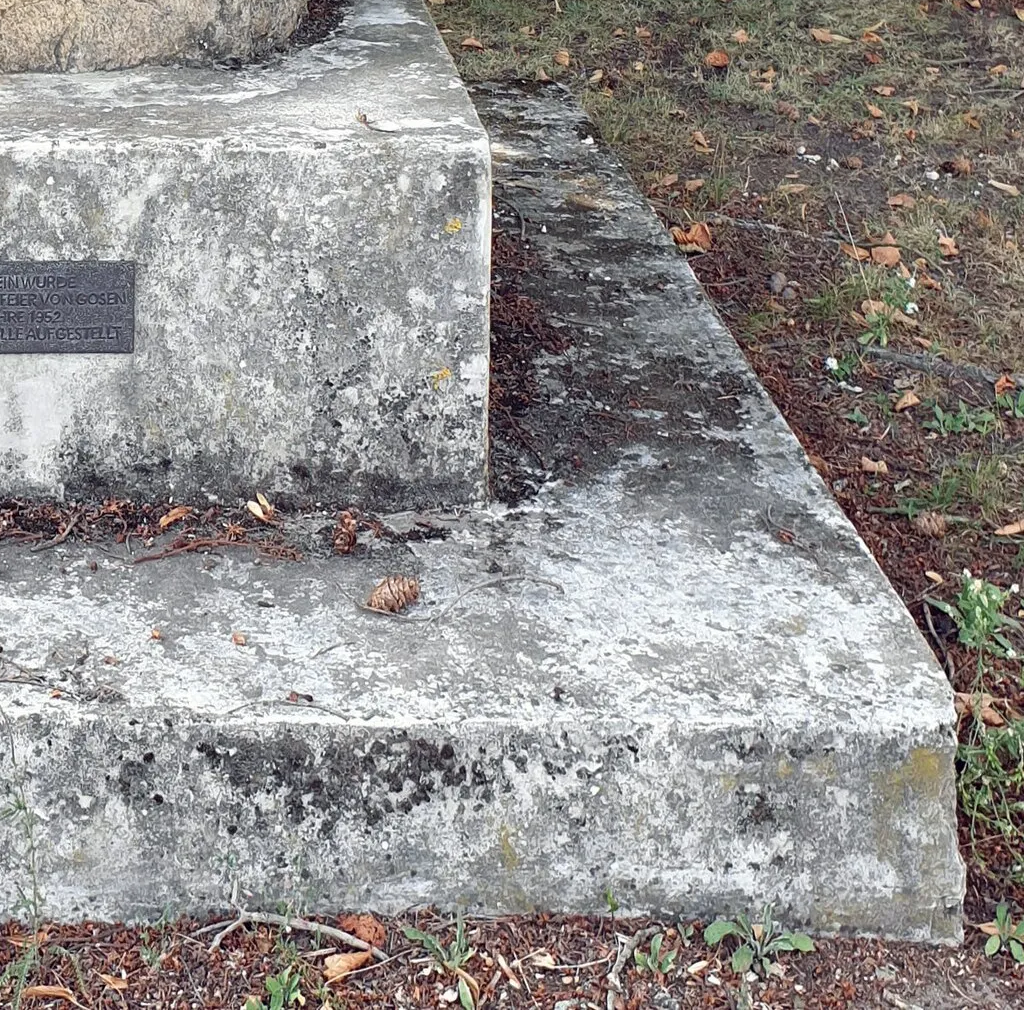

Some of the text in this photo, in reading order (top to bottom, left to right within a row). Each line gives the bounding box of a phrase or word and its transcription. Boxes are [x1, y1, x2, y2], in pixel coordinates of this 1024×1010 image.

[20, 275, 76, 289] WURDE
[40, 292, 73, 306] VON
[74, 292, 127, 306] GOSEN
[29, 310, 61, 323] 1952
[25, 326, 123, 340] AUFGESTELLT
